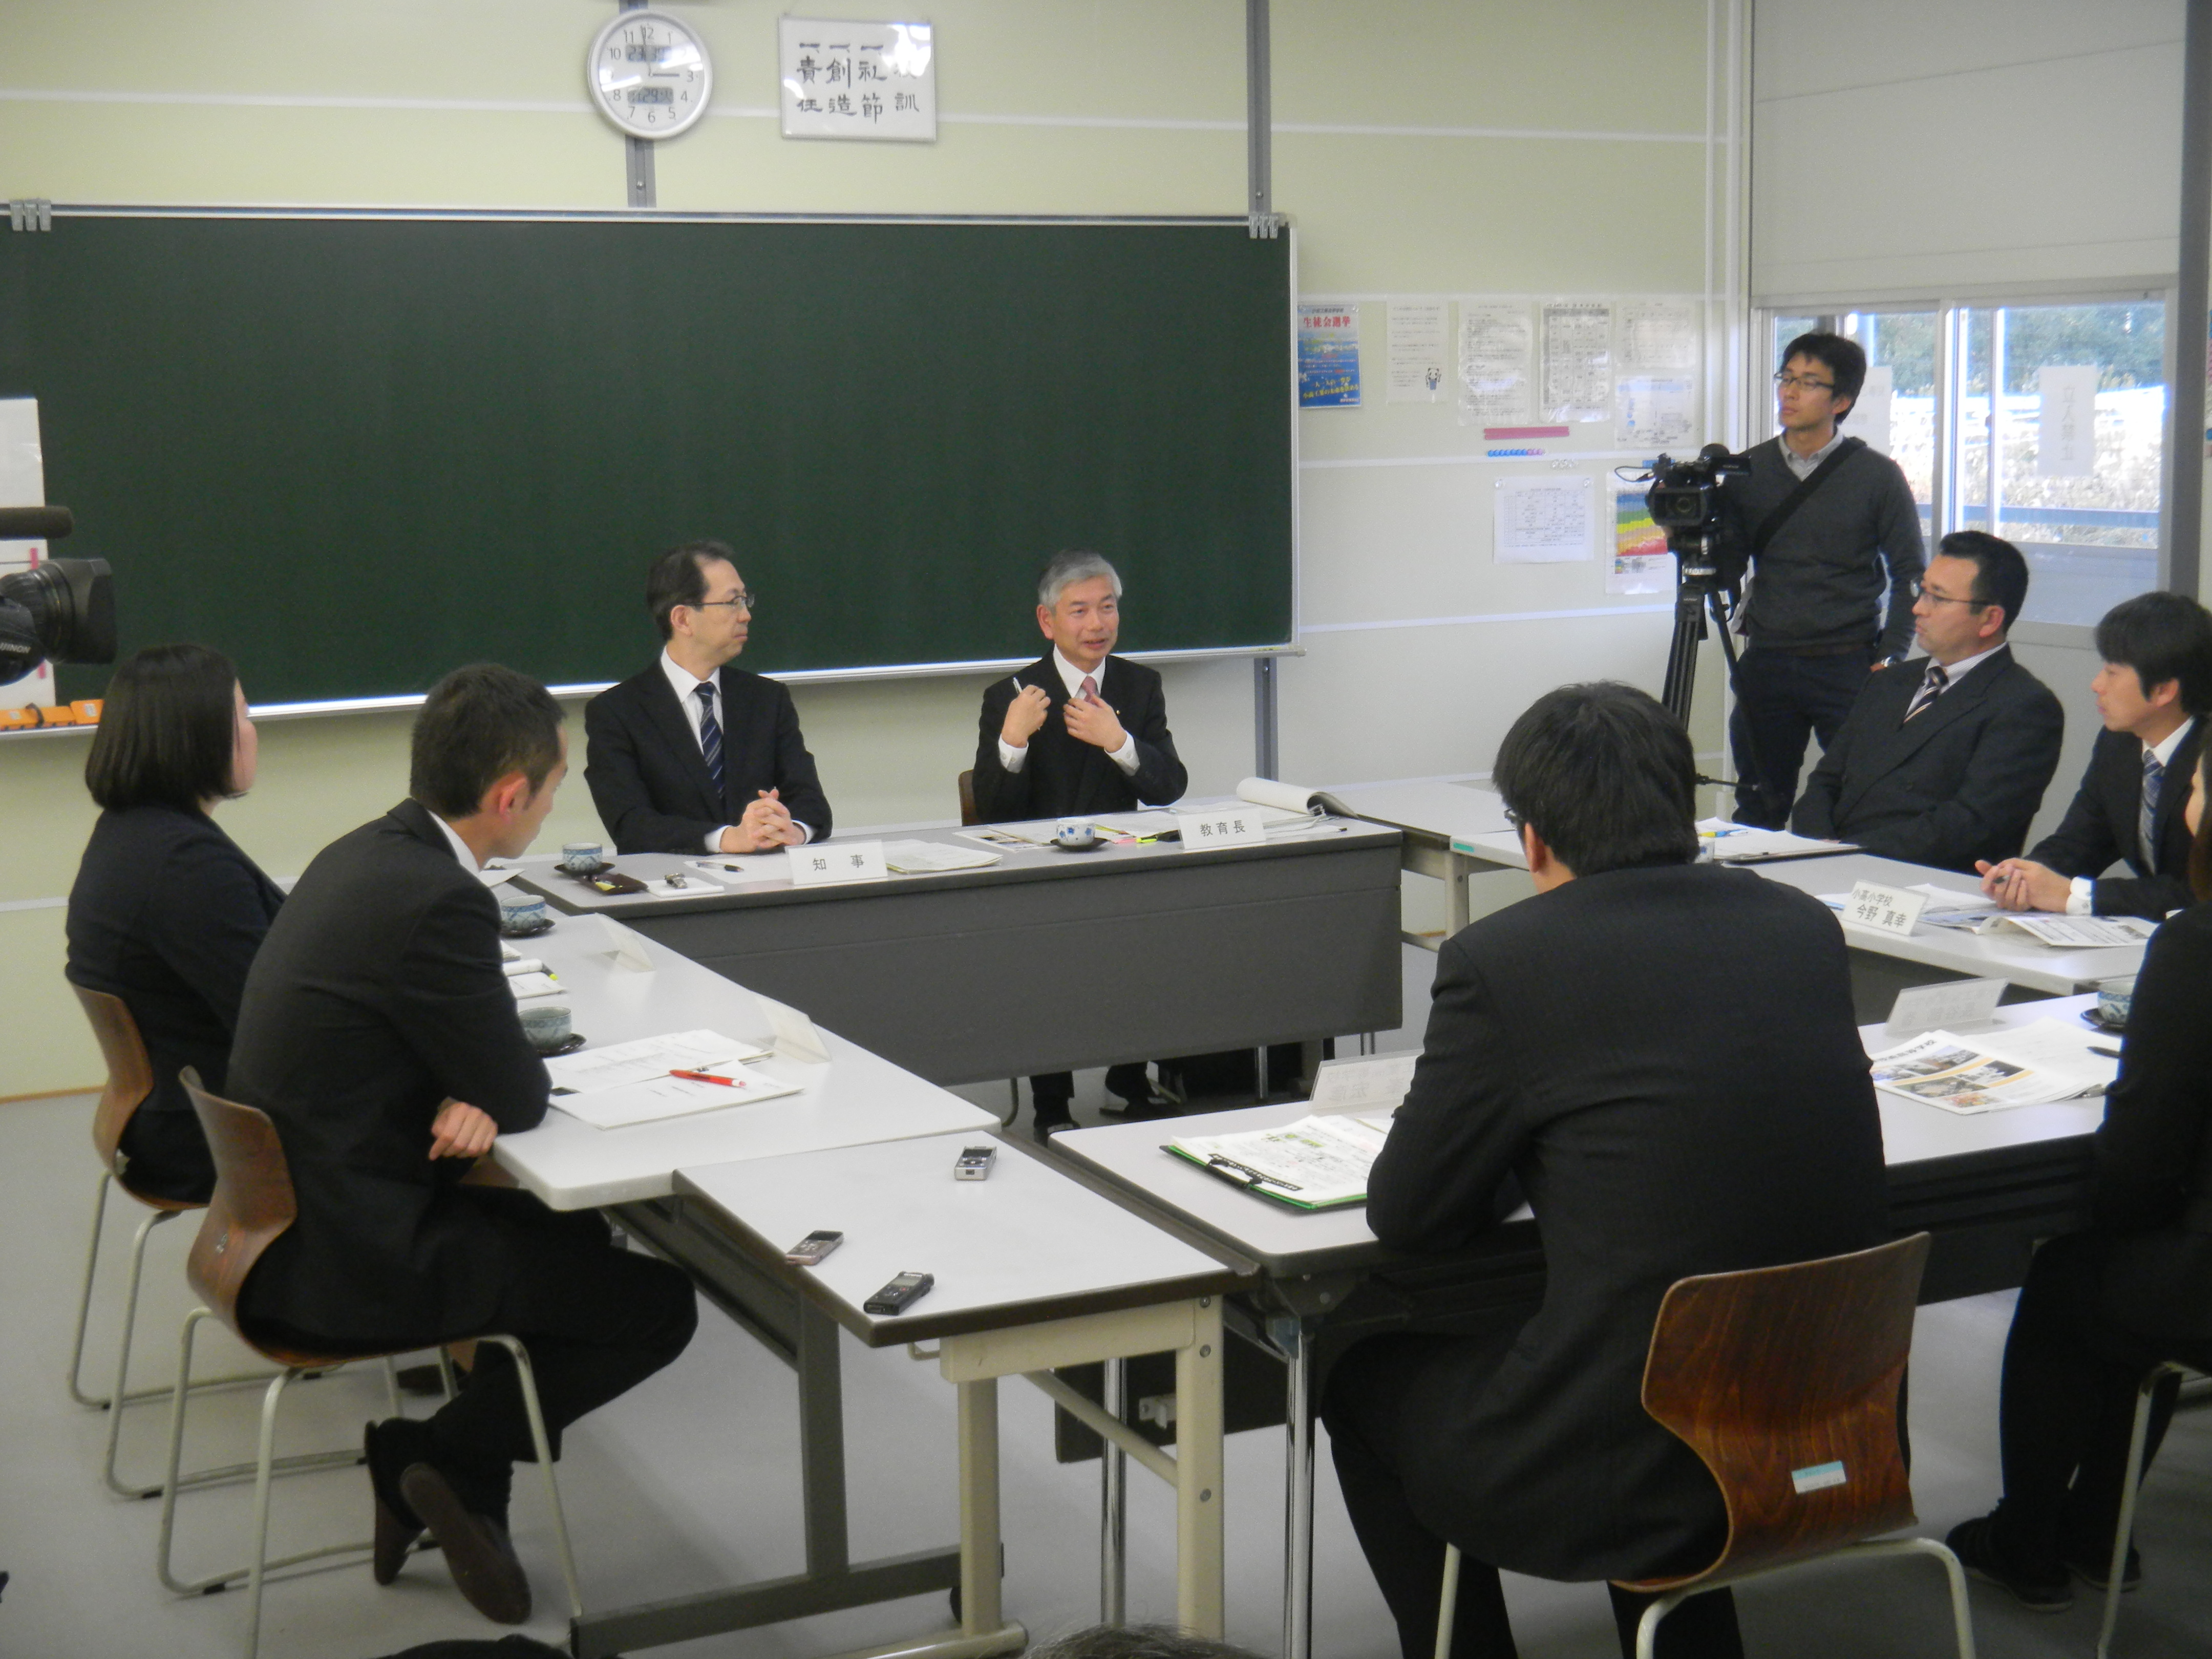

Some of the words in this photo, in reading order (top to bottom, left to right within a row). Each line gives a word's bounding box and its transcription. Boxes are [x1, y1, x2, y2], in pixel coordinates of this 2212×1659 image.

[624, 30, 633, 44] 11
[609, 47, 621, 60] 10
[686, 70, 694, 82] 3
[613, 89, 621, 101] 8
[680, 91, 688, 103] 4
[628, 106, 635, 118] 7
[648, 111, 656, 123] 6
[668, 107, 676, 119] 5
[1200, 820, 1245, 837] 教育長
[1852, 889, 1893, 907] 小高小学校
[1857, 904, 1879, 922] 今野
[1882, 910, 1906, 928] 真幸
